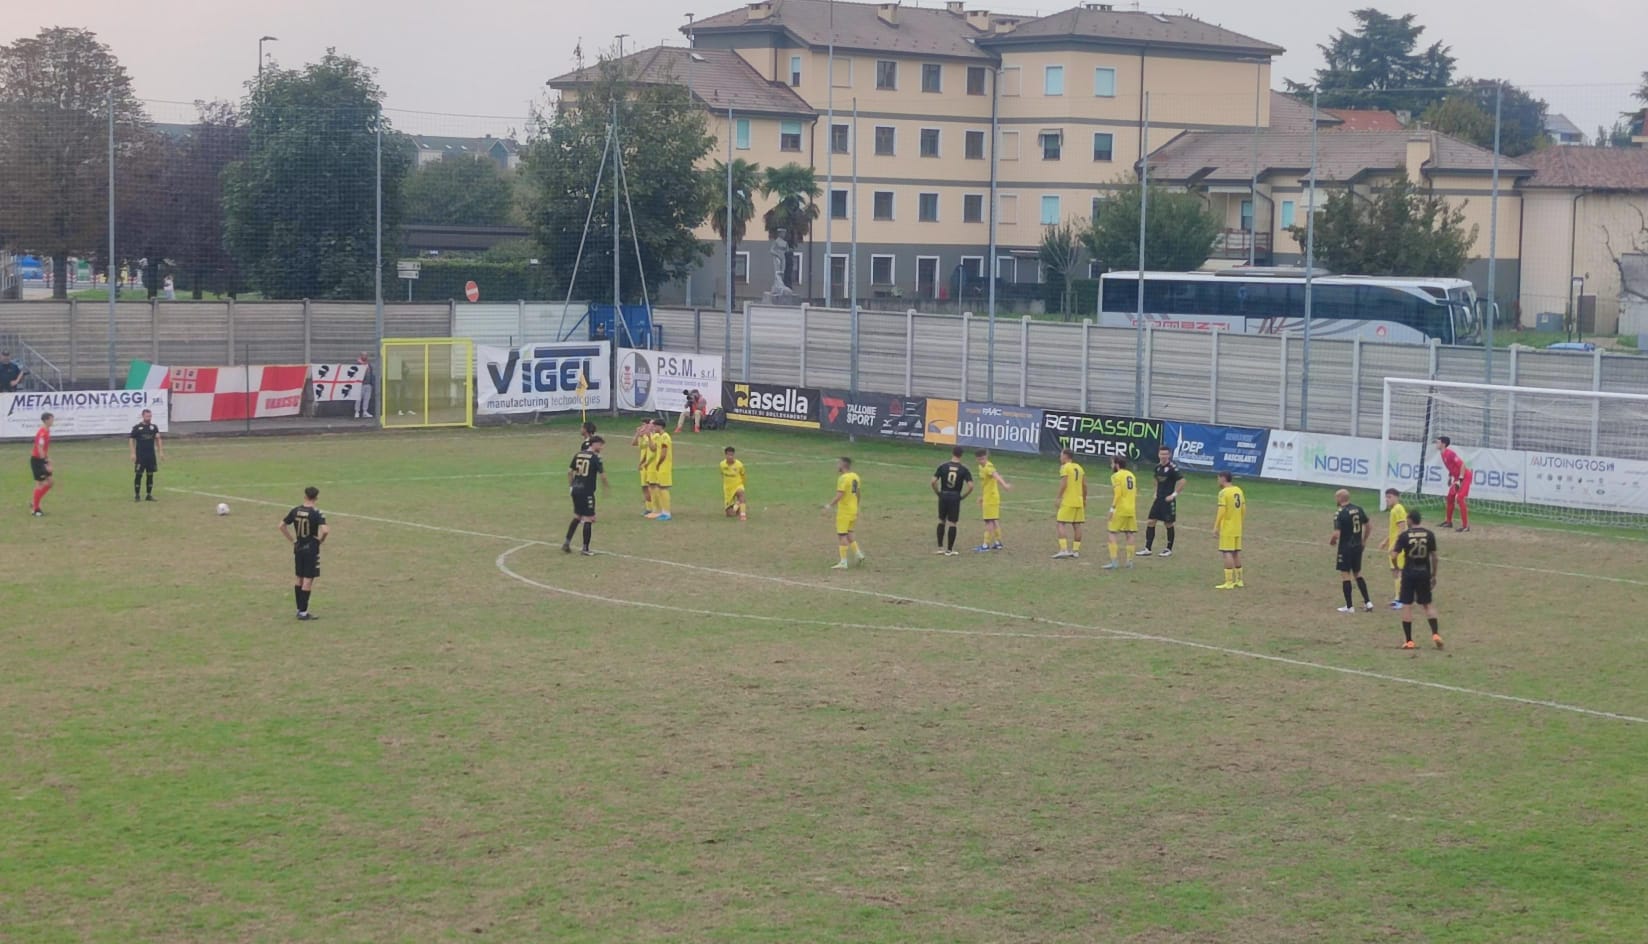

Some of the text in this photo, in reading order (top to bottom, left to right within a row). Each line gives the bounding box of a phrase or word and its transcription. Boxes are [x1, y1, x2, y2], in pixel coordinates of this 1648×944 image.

[487, 347, 600, 394] VIGEL
[657, 356, 697, 378] P.S.M.
[9, 391, 148, 412] METALMONTAGGI
[486, 397, 549, 409] manufacturing
[846, 413, 876, 427] SPORT
[976, 416, 1040, 446] impianti
[1059, 436, 1127, 457] TIPSTER
[1181, 440, 1205, 453] DEP
[575, 459, 590, 477] 50
[1314, 454, 1369, 475] NOBIS
[1126, 476, 1134, 490] 6
[1471, 468, 1519, 489] OBIS
[1233, 493, 1241, 509] 3
[1352, 514, 1361, 533] 6
[1408, 538, 1428, 559] 26
